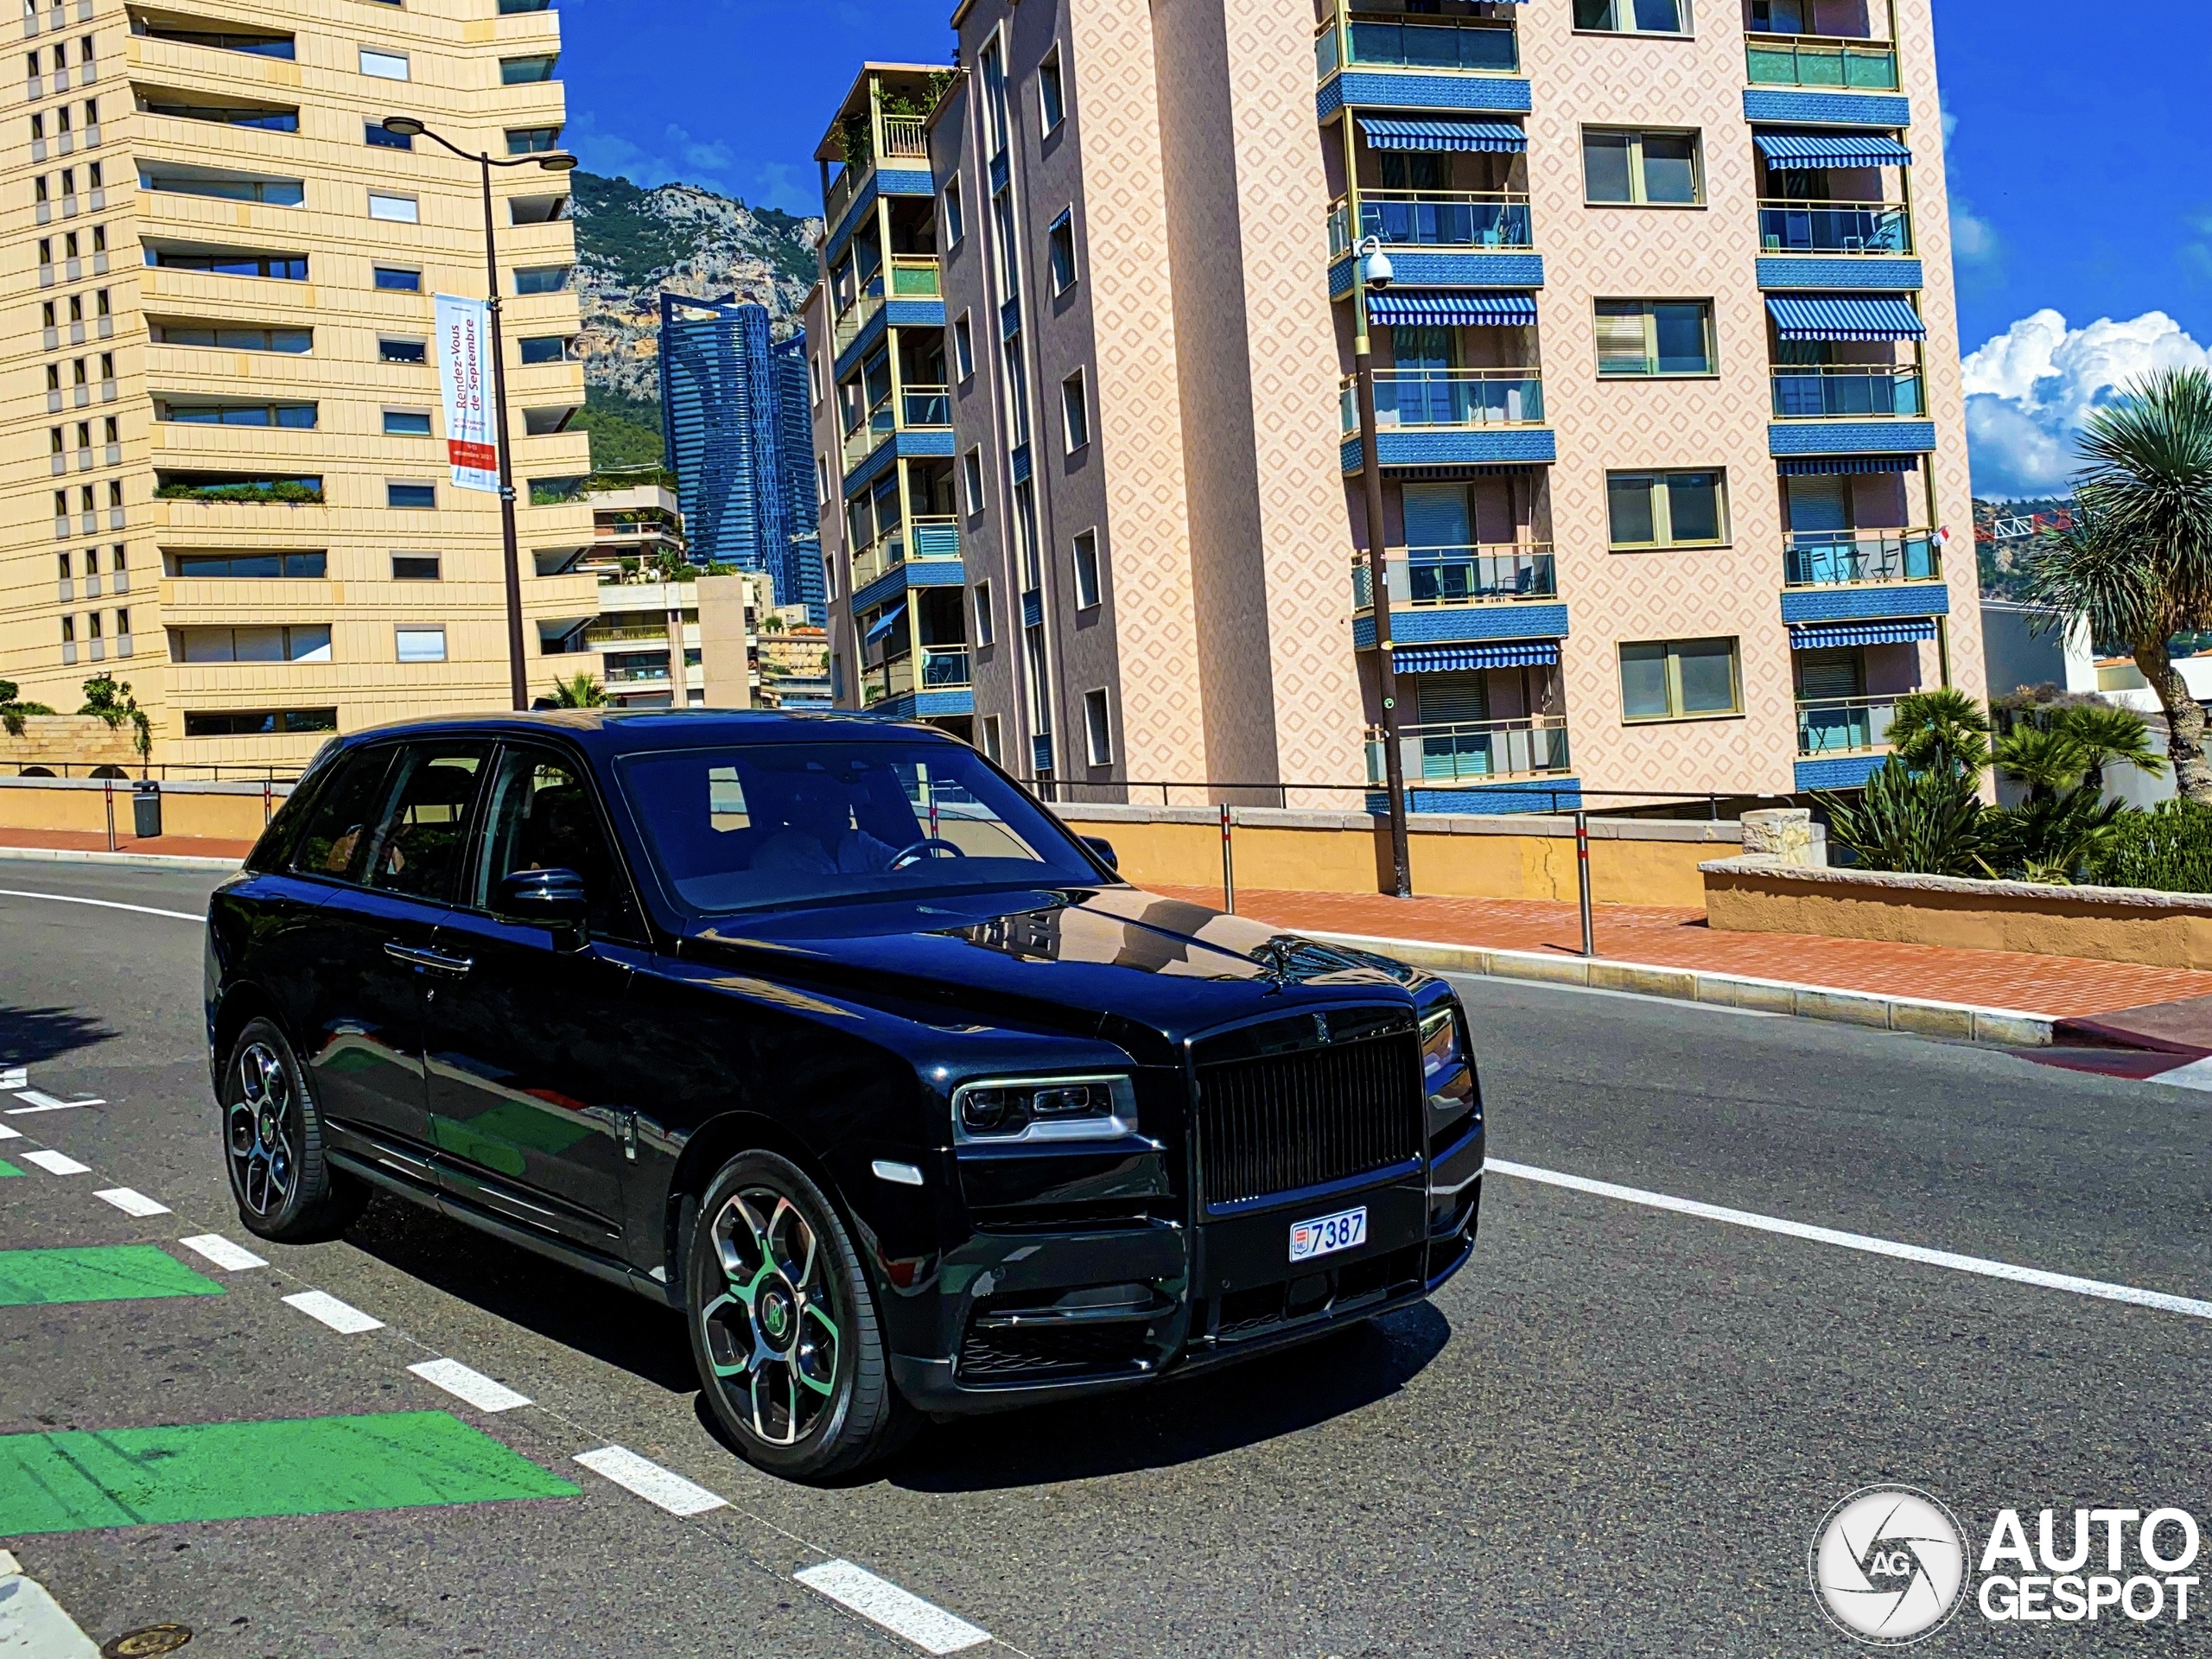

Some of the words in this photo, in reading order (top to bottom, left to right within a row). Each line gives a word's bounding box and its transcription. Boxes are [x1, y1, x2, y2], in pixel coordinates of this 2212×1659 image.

[451, 325, 467, 409] Rendez-Vous
[465, 319, 480, 391] Septembre
[470, 395, 480, 411] de
[1312, 1213, 1363, 1253] 7387
